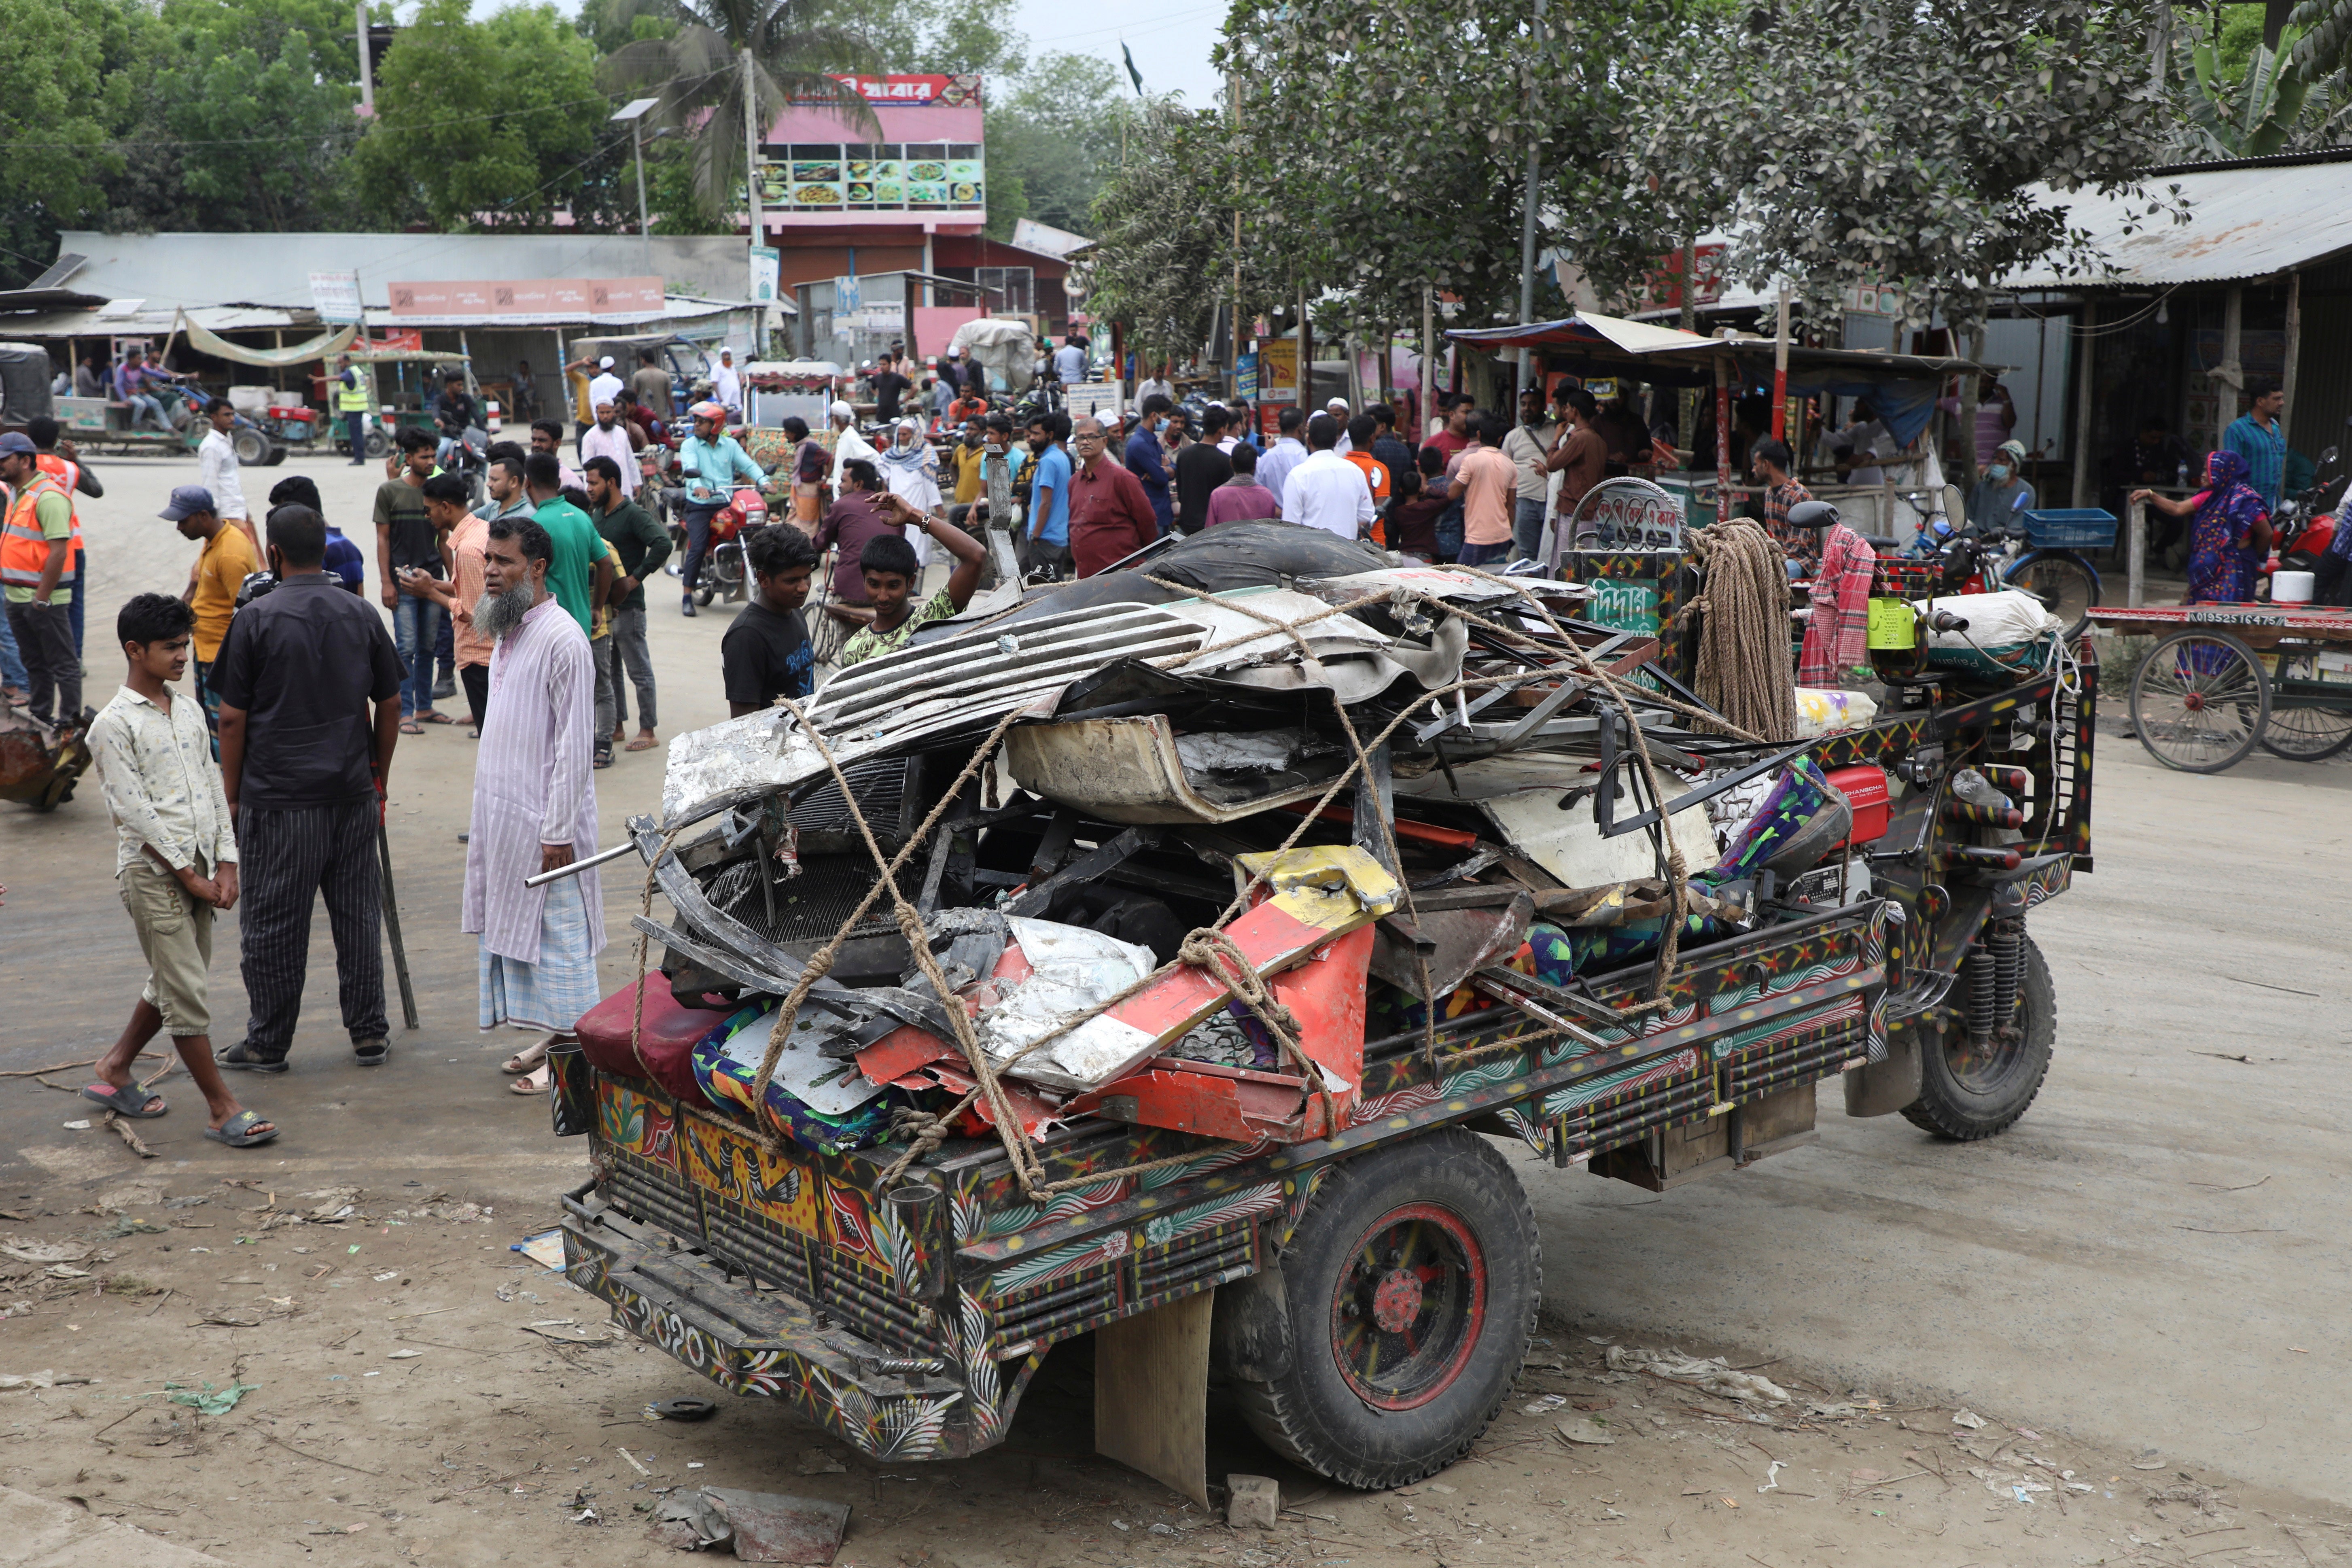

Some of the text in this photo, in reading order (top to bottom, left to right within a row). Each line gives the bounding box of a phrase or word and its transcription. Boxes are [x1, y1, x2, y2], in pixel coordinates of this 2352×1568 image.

[862, 82, 932, 100] খাবার
[1592, 578, 1651, 624] দিদার
[1844, 784, 1884, 796] CHANGCHAI
[1419, 1166, 1501, 1216] SAMRAT
[638, 1296, 705, 1367] 2020
